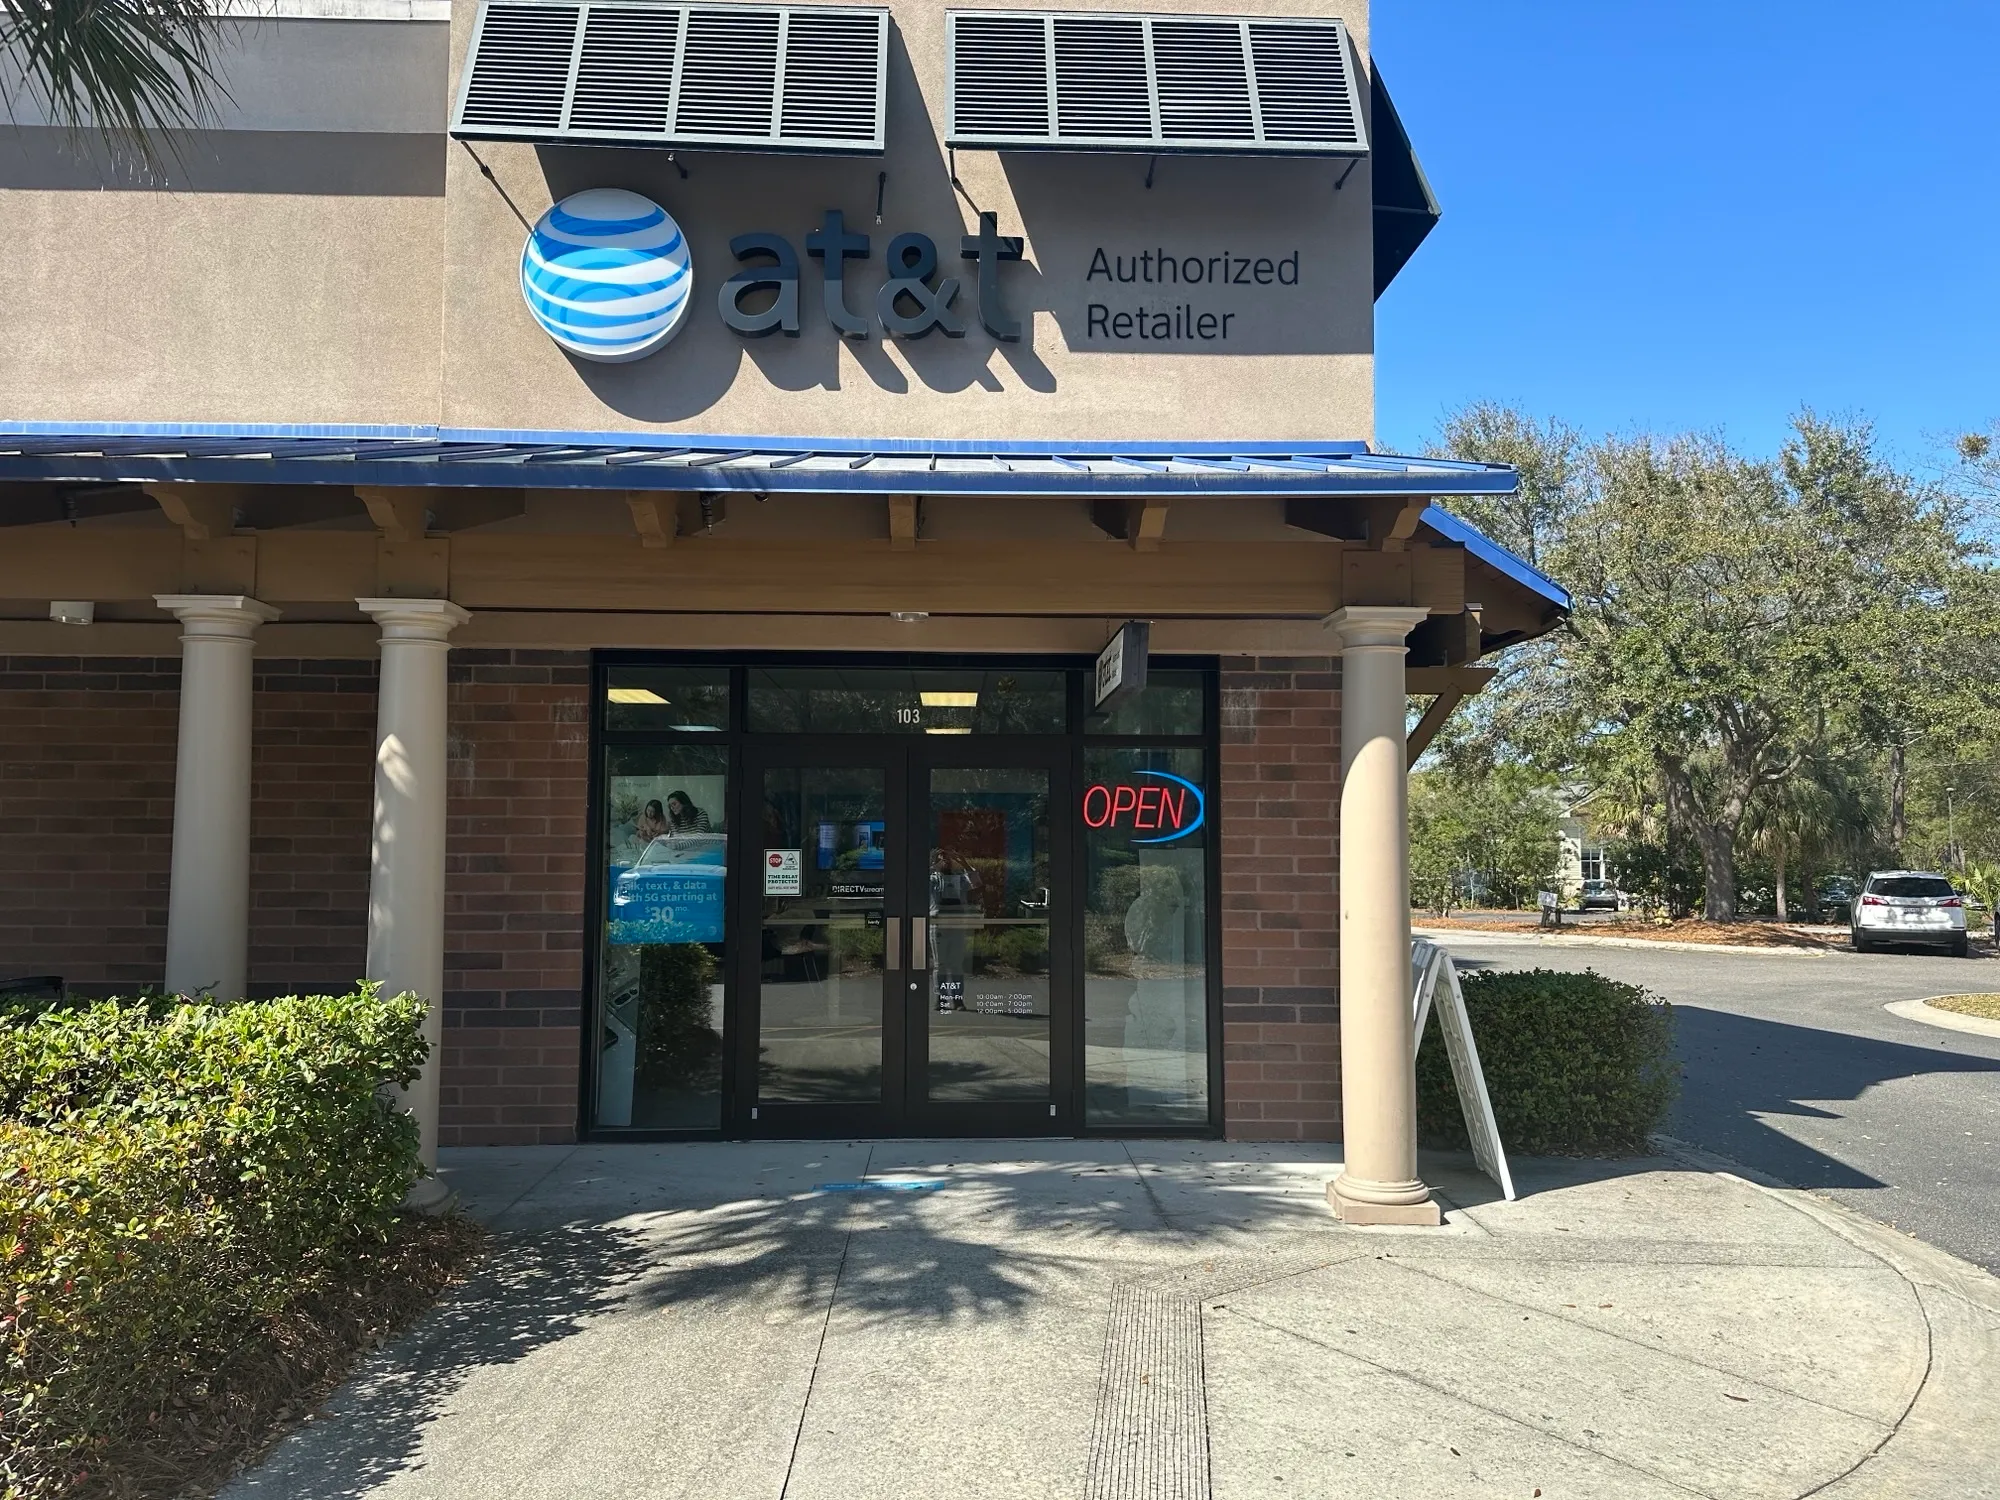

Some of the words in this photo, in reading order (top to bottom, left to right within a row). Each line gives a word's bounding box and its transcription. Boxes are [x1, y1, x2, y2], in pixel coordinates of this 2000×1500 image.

[717, 209, 1025, 342] at&t
[1086, 246, 1301, 286] Authorized
[1086, 303, 1236, 340] Retailer
[897, 708, 921, 724] 103
[1082, 784, 1186, 829] OPEN
[619, 891, 642, 902] ith
[644, 892, 659, 902] 5G
[660, 891, 704, 904] starting
[706, 892, 718, 901] at
[620, 880, 644, 892] alk,
[645, 881, 671, 891] text,
[673, 880, 682, 890] &
[683, 880, 707, 890] data
[832, 885, 865, 893] DIRECTV
